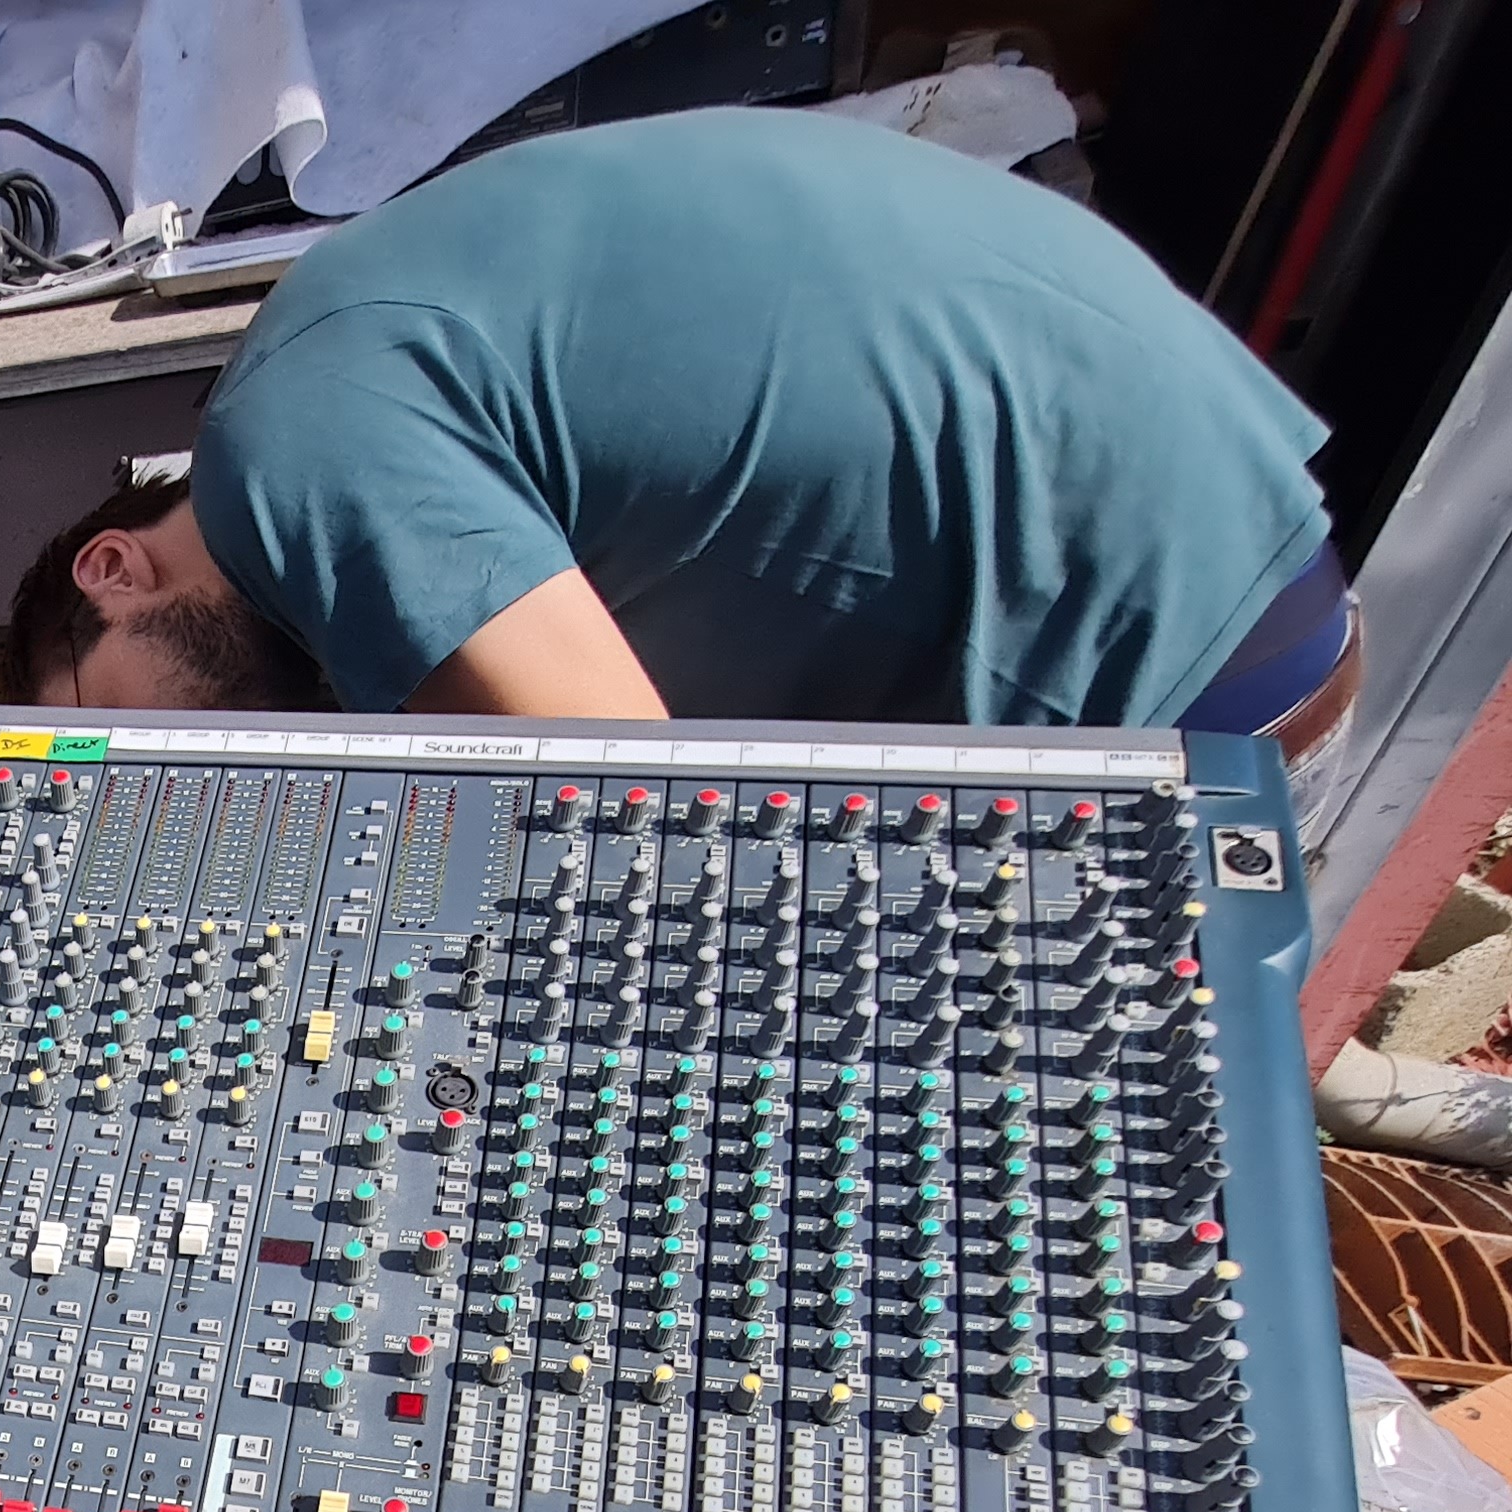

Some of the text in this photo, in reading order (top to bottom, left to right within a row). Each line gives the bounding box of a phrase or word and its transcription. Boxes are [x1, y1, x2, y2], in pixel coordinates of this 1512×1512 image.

[424, 741, 523, 756] Soundcraft
[705, 1381, 722, 1389] PAN
[791, 1391, 809, 1399] PAN
[877, 1400, 896, 1409] PAN
[359, 1494, 383, 1505] LEVEL
